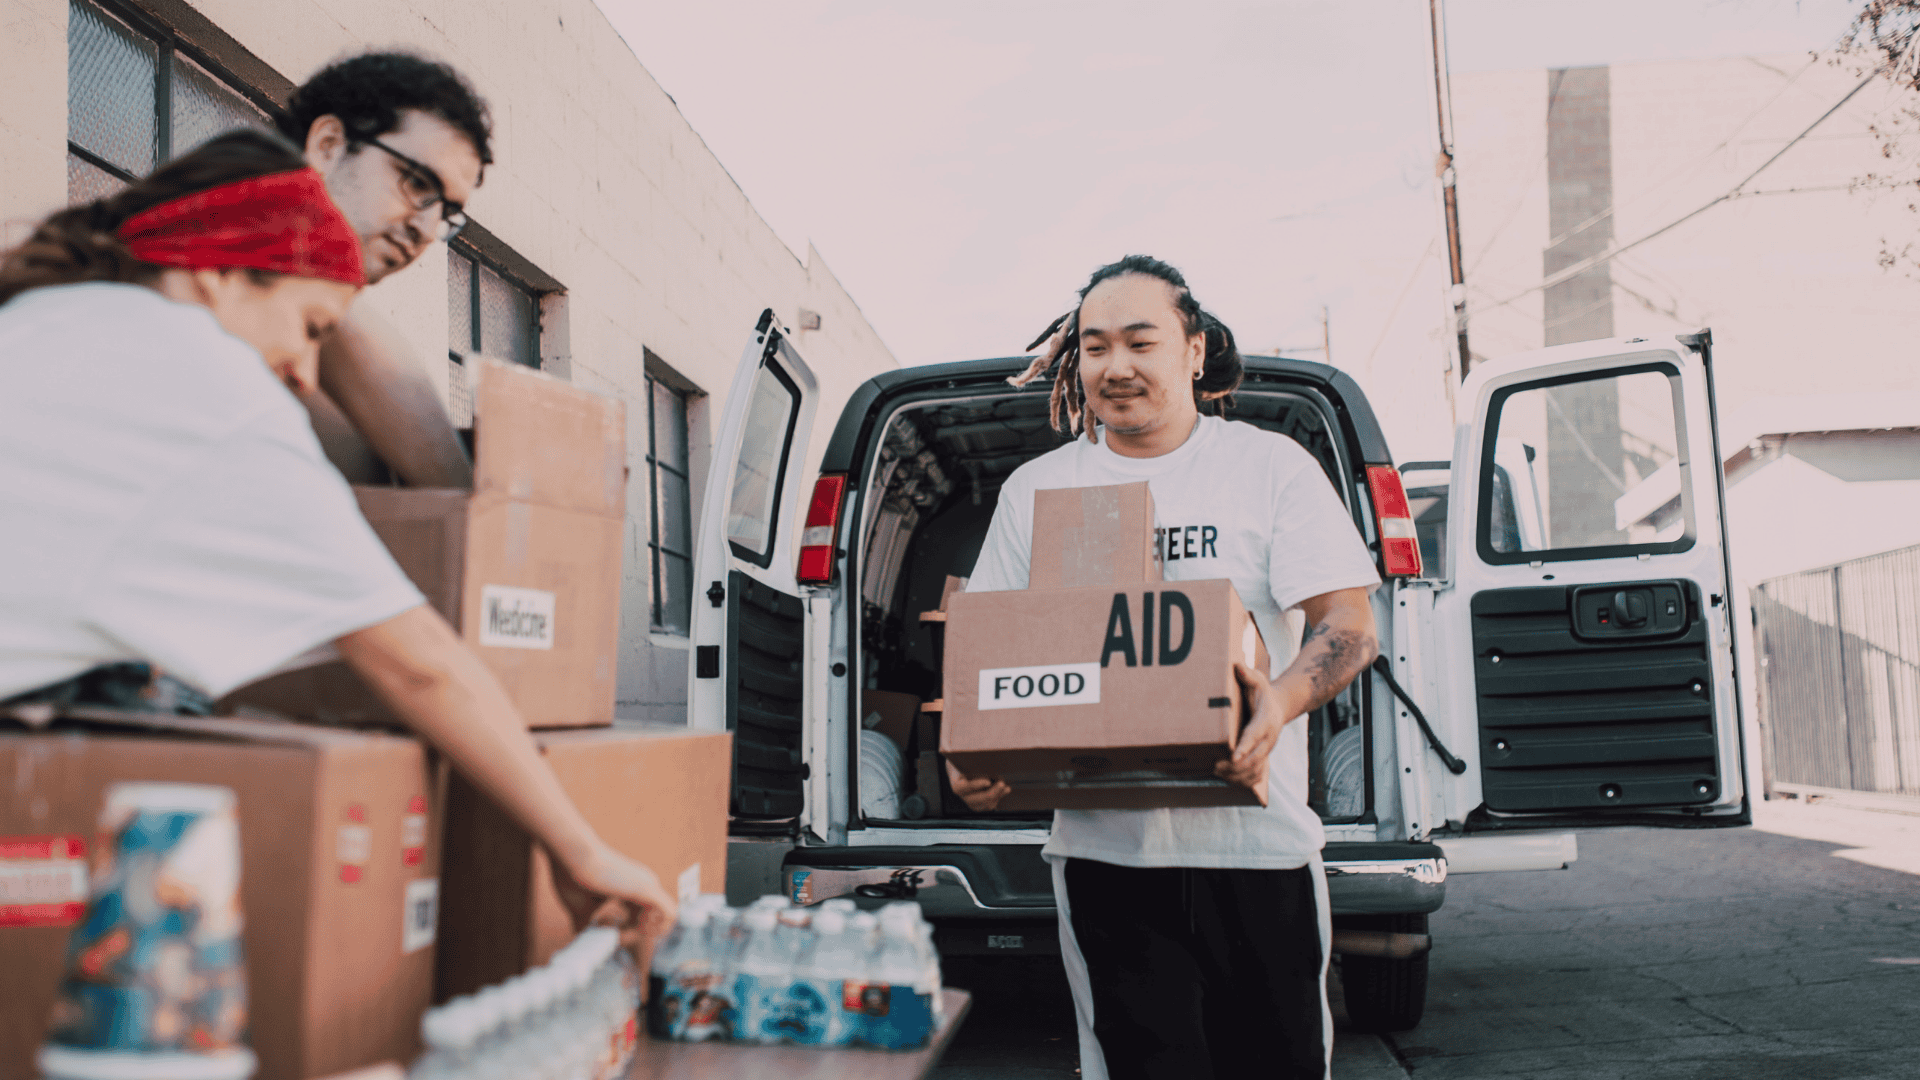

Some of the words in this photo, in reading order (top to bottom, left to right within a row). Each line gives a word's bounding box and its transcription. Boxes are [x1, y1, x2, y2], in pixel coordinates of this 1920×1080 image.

[1160, 525, 1218, 561] EER
[1100, 590, 1195, 668] AID
[994, 672, 1085, 700] FOOD
